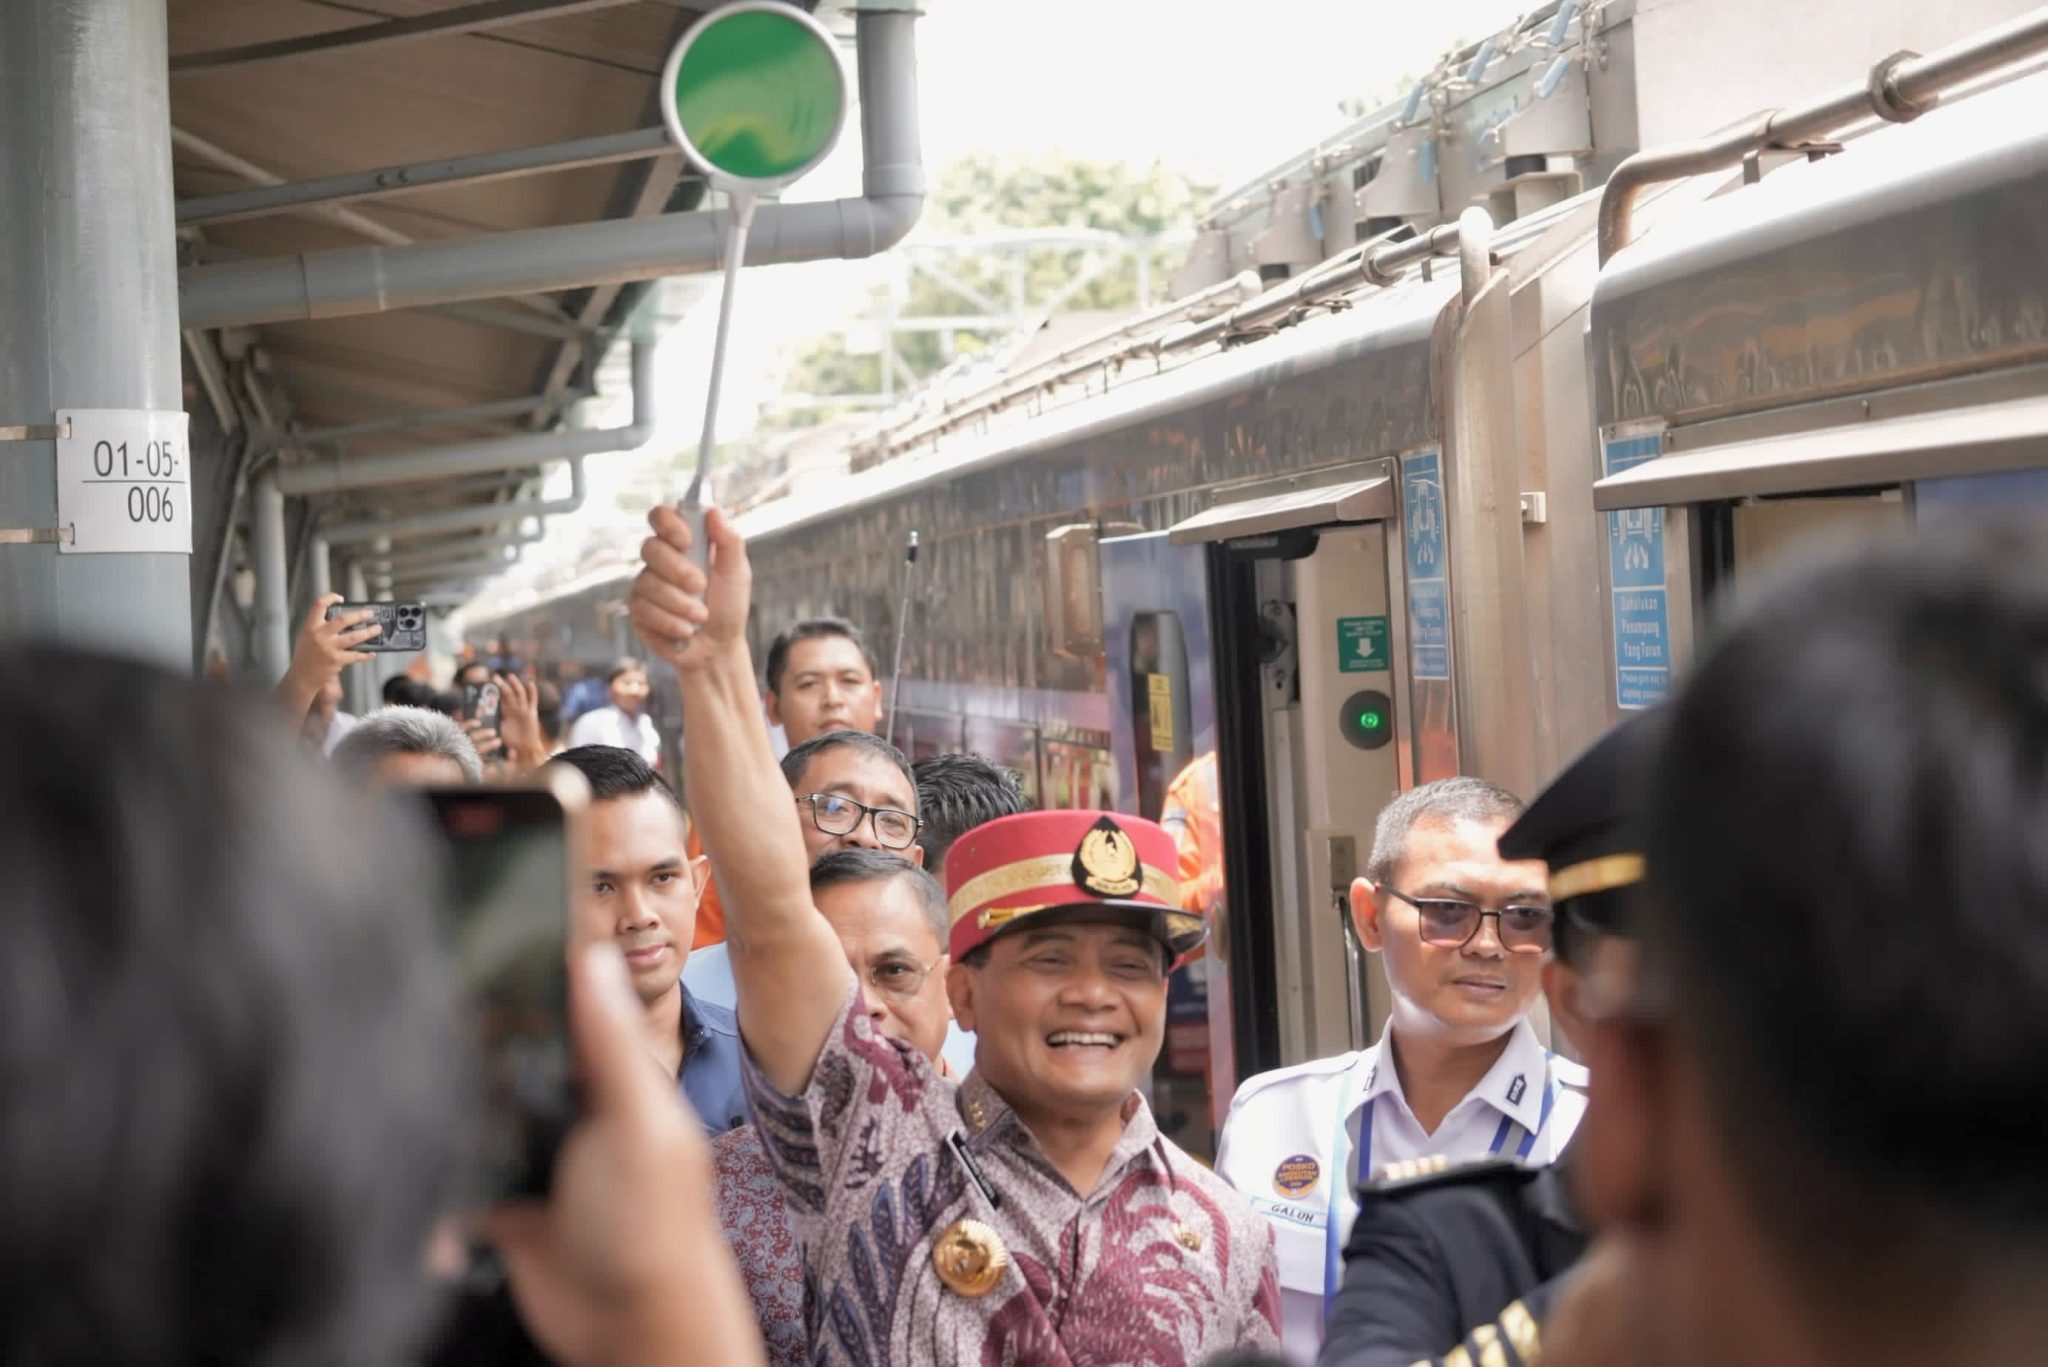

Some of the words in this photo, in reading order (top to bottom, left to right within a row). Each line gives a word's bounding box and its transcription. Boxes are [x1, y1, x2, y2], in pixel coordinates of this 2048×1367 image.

[127, 486, 173, 522] 006
[1622, 619, 1659, 638] Penumpang
[1624, 642, 1641, 660] Yang
[1640, 642, 1661, 657] Turun
[1282, 1162, 1316, 1171] POSKO
[1271, 1204, 1314, 1222] GALUH
